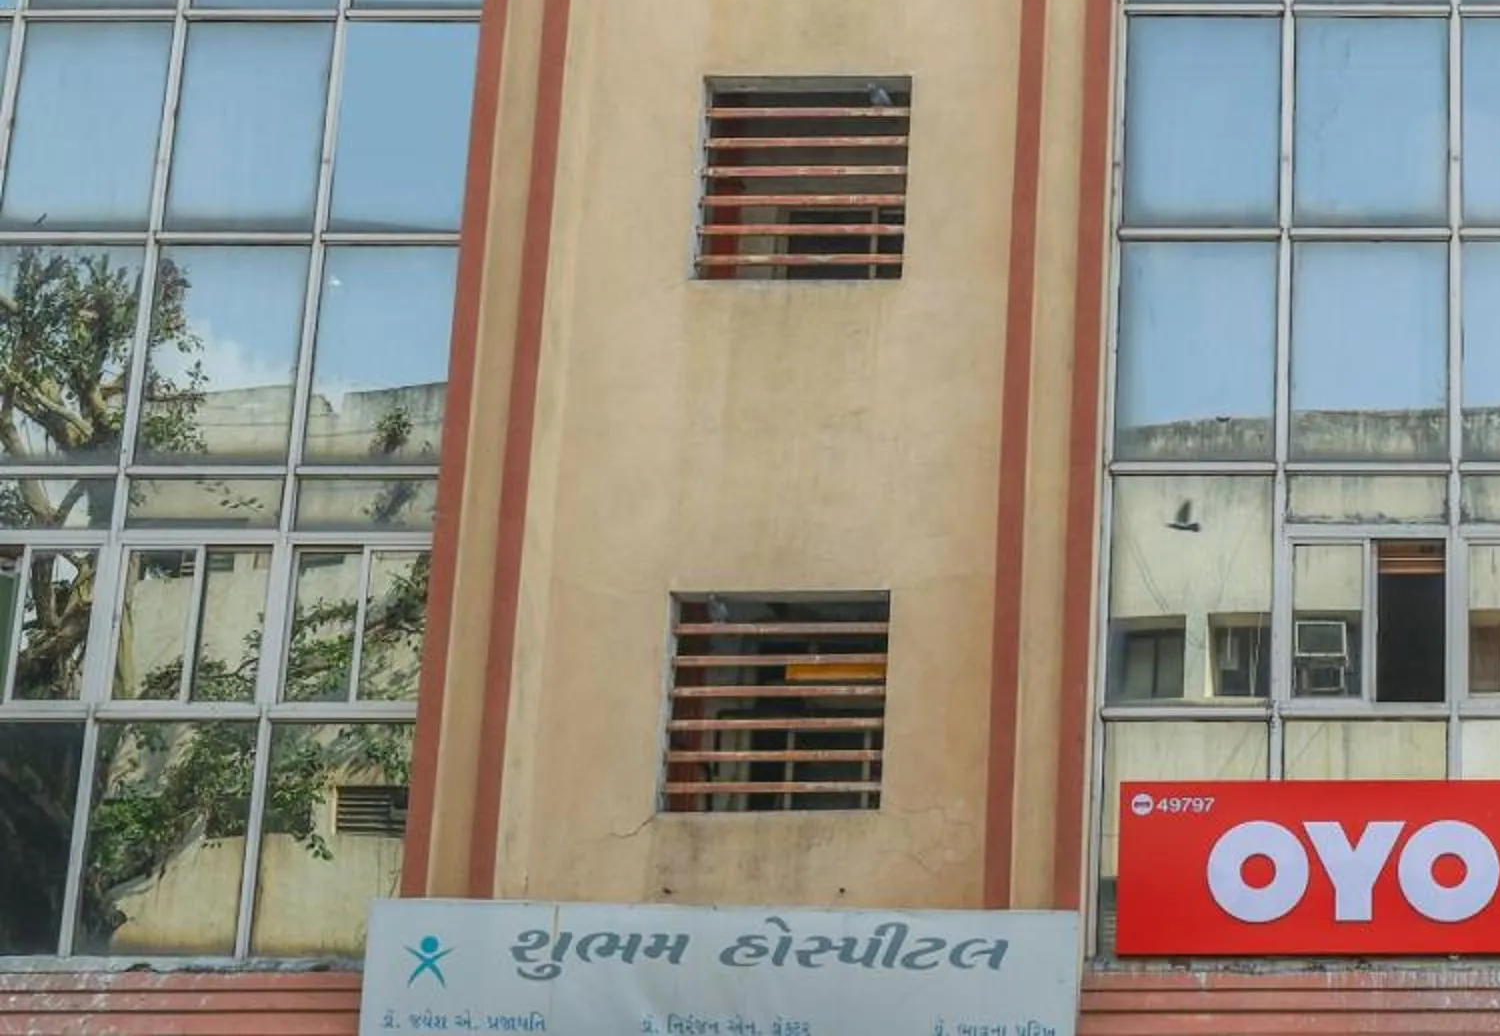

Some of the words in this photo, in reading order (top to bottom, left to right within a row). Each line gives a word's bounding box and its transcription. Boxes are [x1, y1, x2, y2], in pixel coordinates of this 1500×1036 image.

[1156, 796, 1215, 813] 49797
[1206, 819, 1500, 924] OYO
[509, 928, 691, 982] શુભમ
[718, 916, 1010, 972] હોસ્પીટલ
